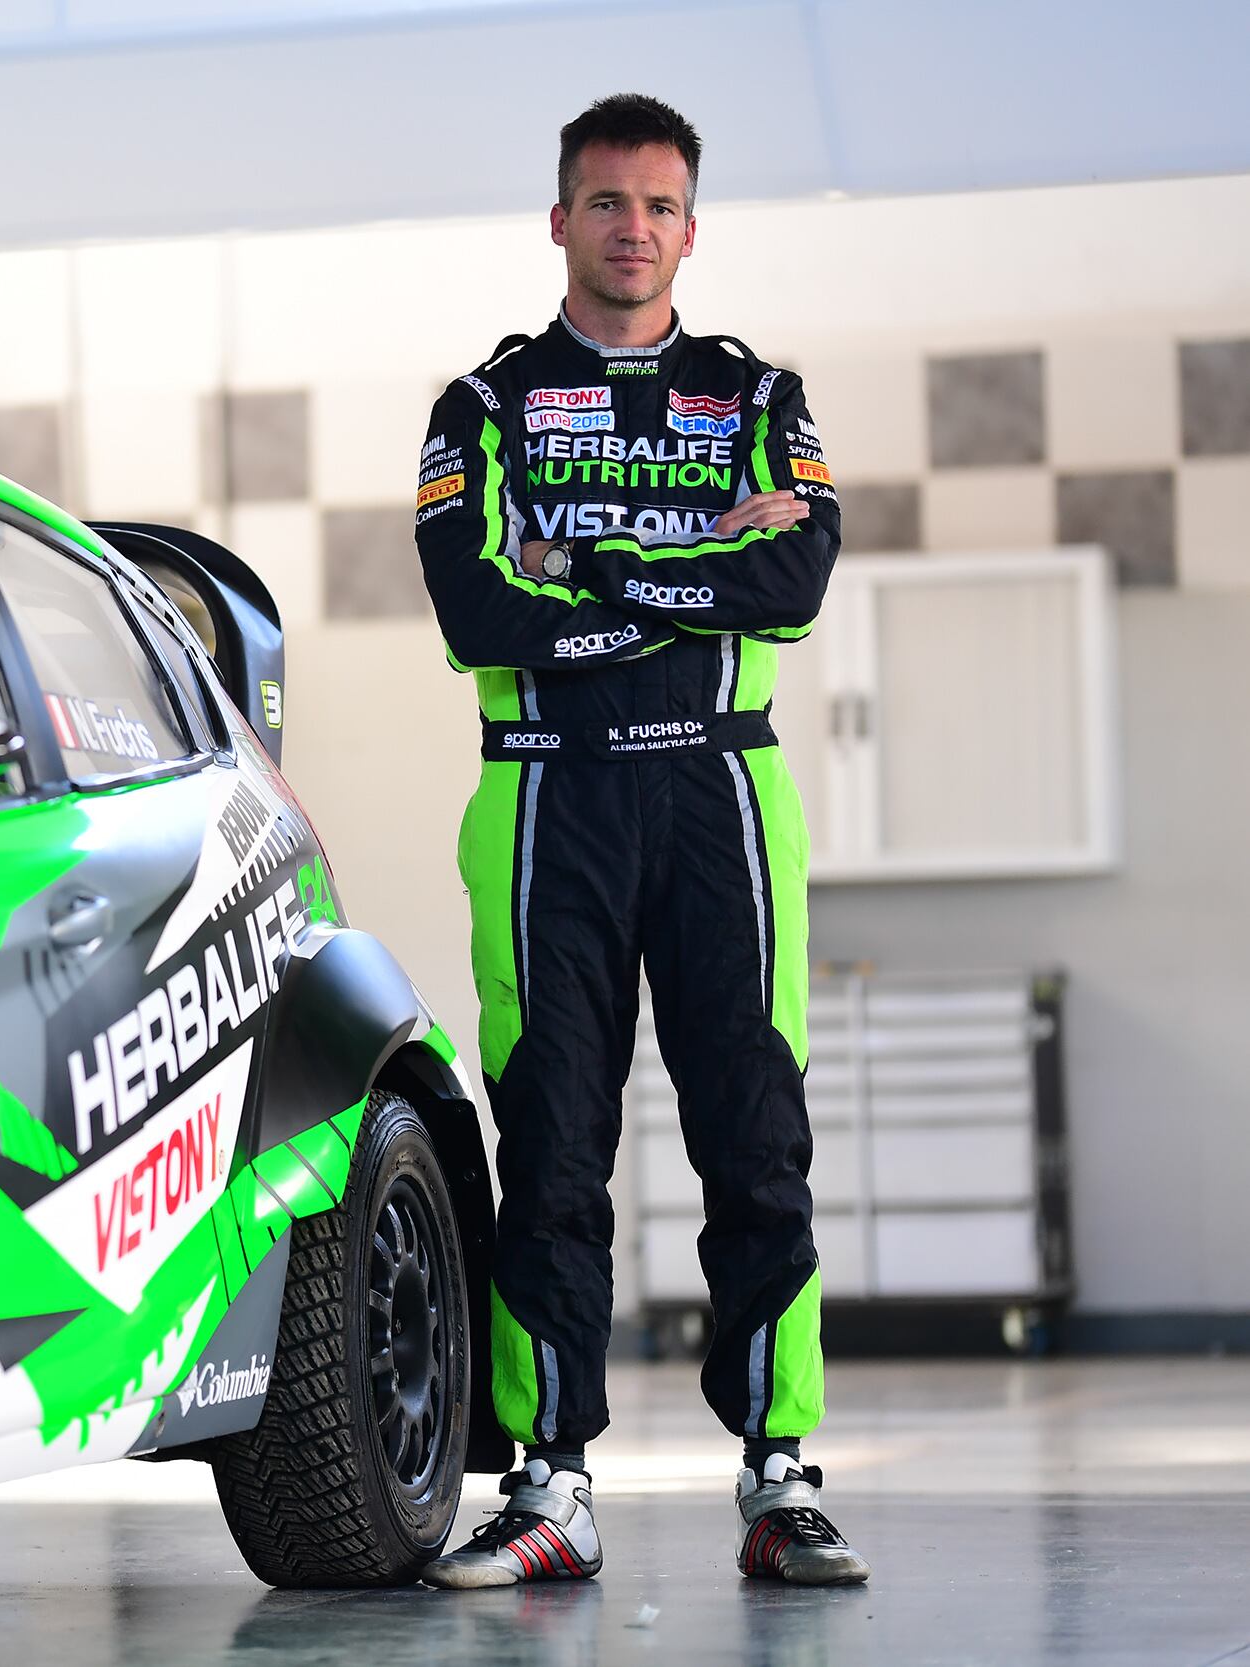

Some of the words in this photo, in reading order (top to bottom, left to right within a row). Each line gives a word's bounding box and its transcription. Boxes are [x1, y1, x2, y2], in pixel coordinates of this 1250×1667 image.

[605, 367, 659, 376] NUTRITION
[607, 360, 659, 369] HERBALIFE
[526, 389, 606, 406] VISTONY
[672, 414, 739, 436] RENOVA
[524, 434, 733, 465] HERBALIFE
[526, 460, 732, 493] NUTRITION
[416, 497, 463, 525] Columbia
[624, 578, 714, 605] sparco
[554, 623, 640, 659] sparco
[504, 733, 561, 748] sparco
[608, 727, 624, 741] N.
[629, 721, 683, 740] FUCHS
[684, 721, 704, 734] O+
[610, 743, 646, 751] ALERGIA
[647, 738, 688, 750] SALICYLIC
[688, 735, 707, 745] ACID
[217, 780, 271, 868] RENOVA
[196, 1354, 271, 1408] Columbia
